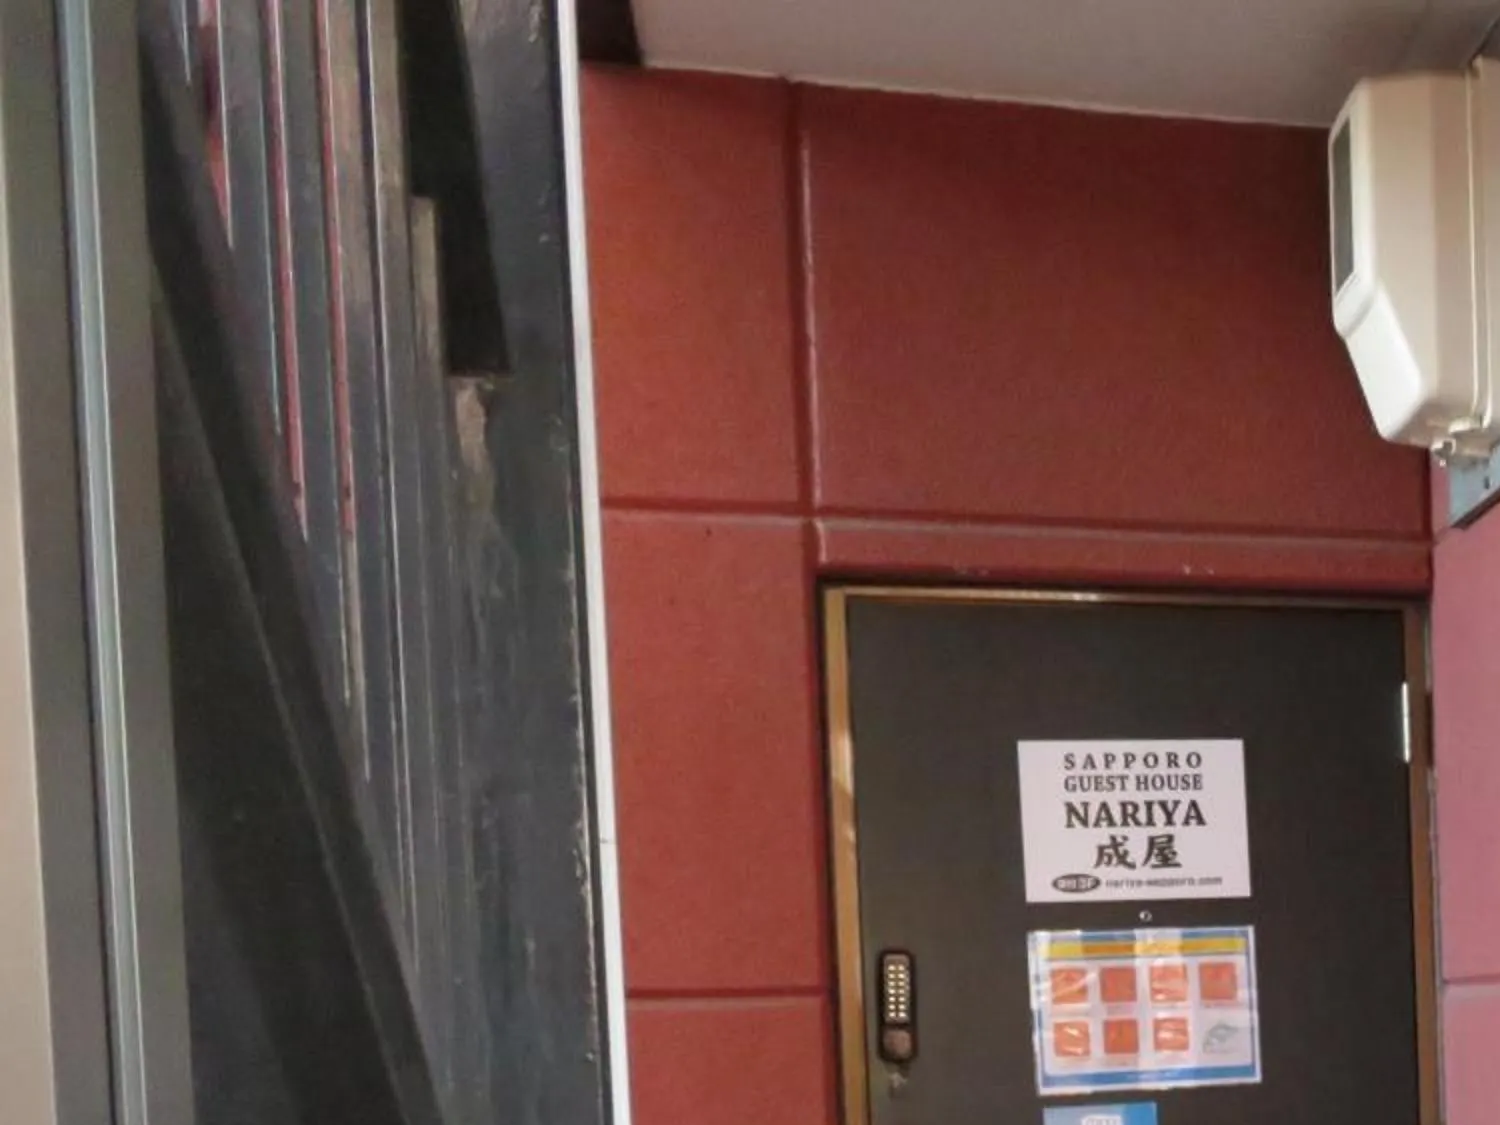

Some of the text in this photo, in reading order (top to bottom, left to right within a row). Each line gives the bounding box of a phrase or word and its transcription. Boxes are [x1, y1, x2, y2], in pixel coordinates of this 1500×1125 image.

[1063, 752, 1203, 770] SAPPORO
[1063, 773, 1204, 793] GUEST HOUSE
[1063, 799, 1208, 828] NARIYA
[1093, 833, 1183, 869] 成屋
